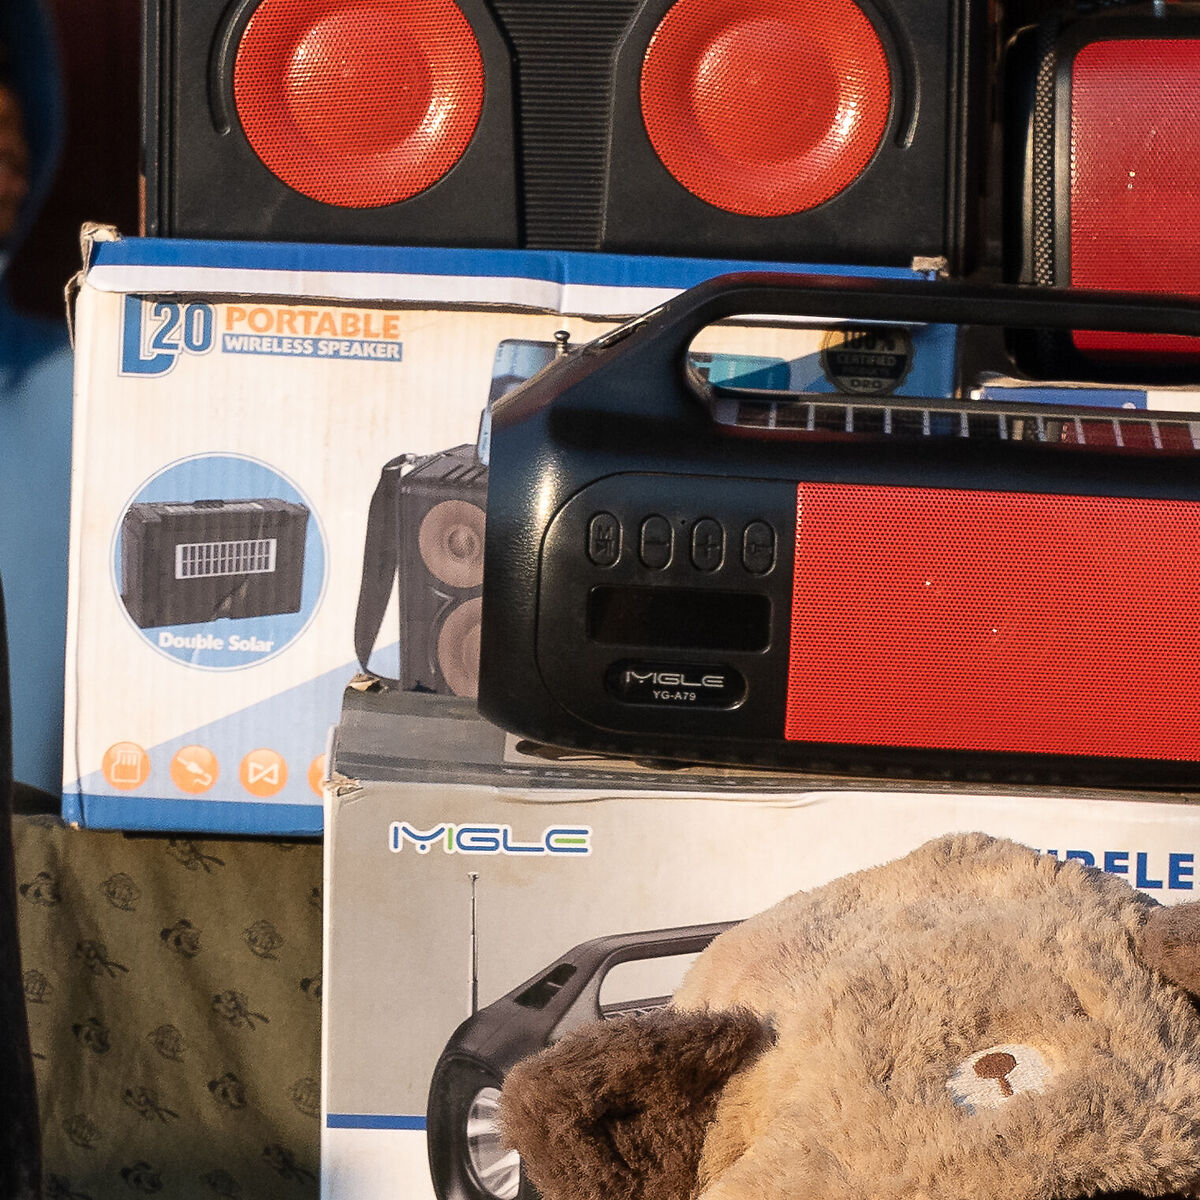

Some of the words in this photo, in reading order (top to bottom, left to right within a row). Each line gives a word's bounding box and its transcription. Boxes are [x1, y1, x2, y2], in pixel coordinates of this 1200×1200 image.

[224, 306, 401, 340] PORTABLE
[225, 335, 314, 357] WIRELESS
[317, 339, 400, 359] SPEAKER
[158, 631, 224, 650] Double
[228, 635, 275, 652] Solar
[652, 690, 696, 701] YG-A79
